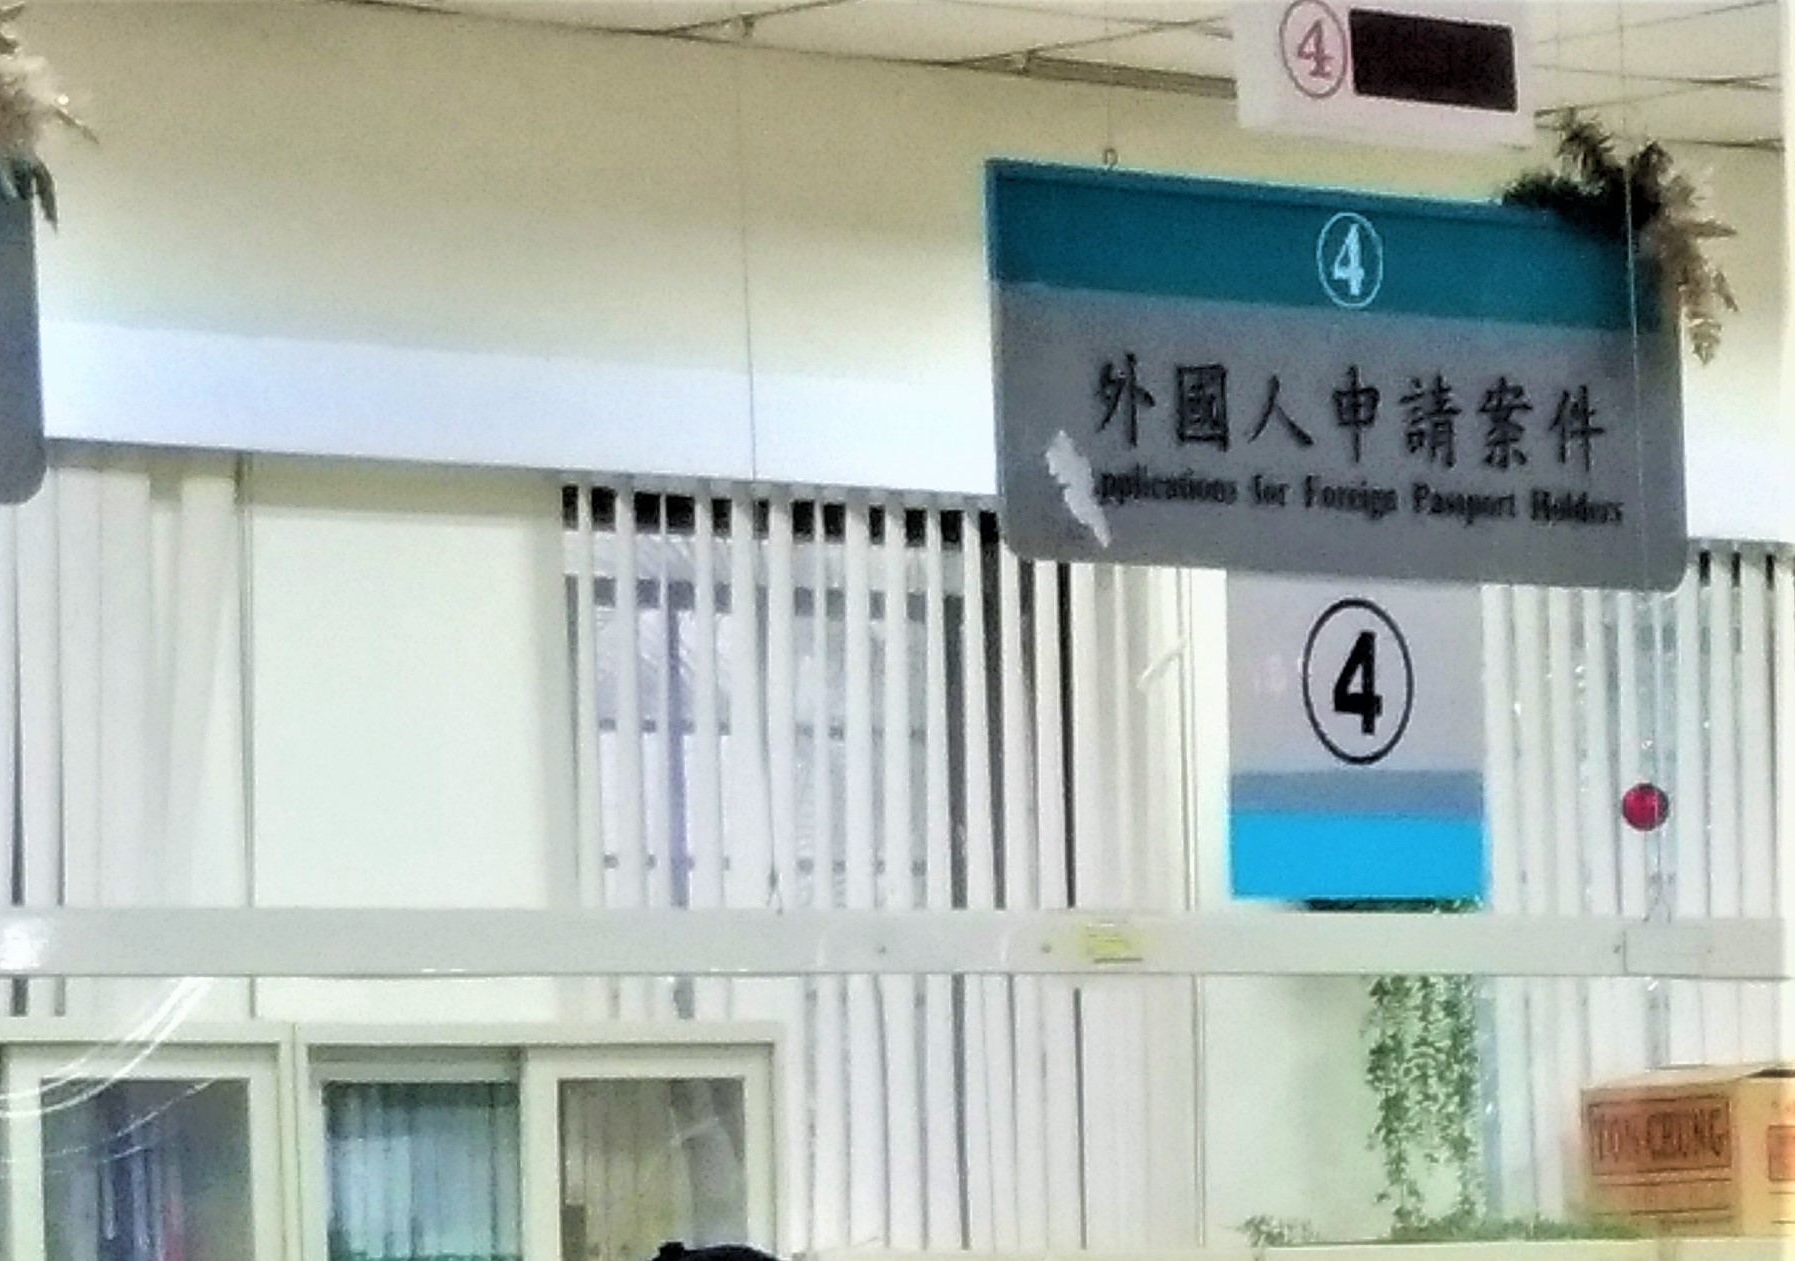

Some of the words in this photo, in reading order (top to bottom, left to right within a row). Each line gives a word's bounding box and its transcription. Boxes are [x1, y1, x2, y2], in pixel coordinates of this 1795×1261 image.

[1095, 353, 1605, 474] 外國人申請案件
[1094, 463, 1238, 506] pplications
[1252, 473, 1289, 507] for
[1305, 474, 1397, 520] Foreign
[1412, 482, 1515, 527] Passport
[1531, 488, 1624, 524] Holders
